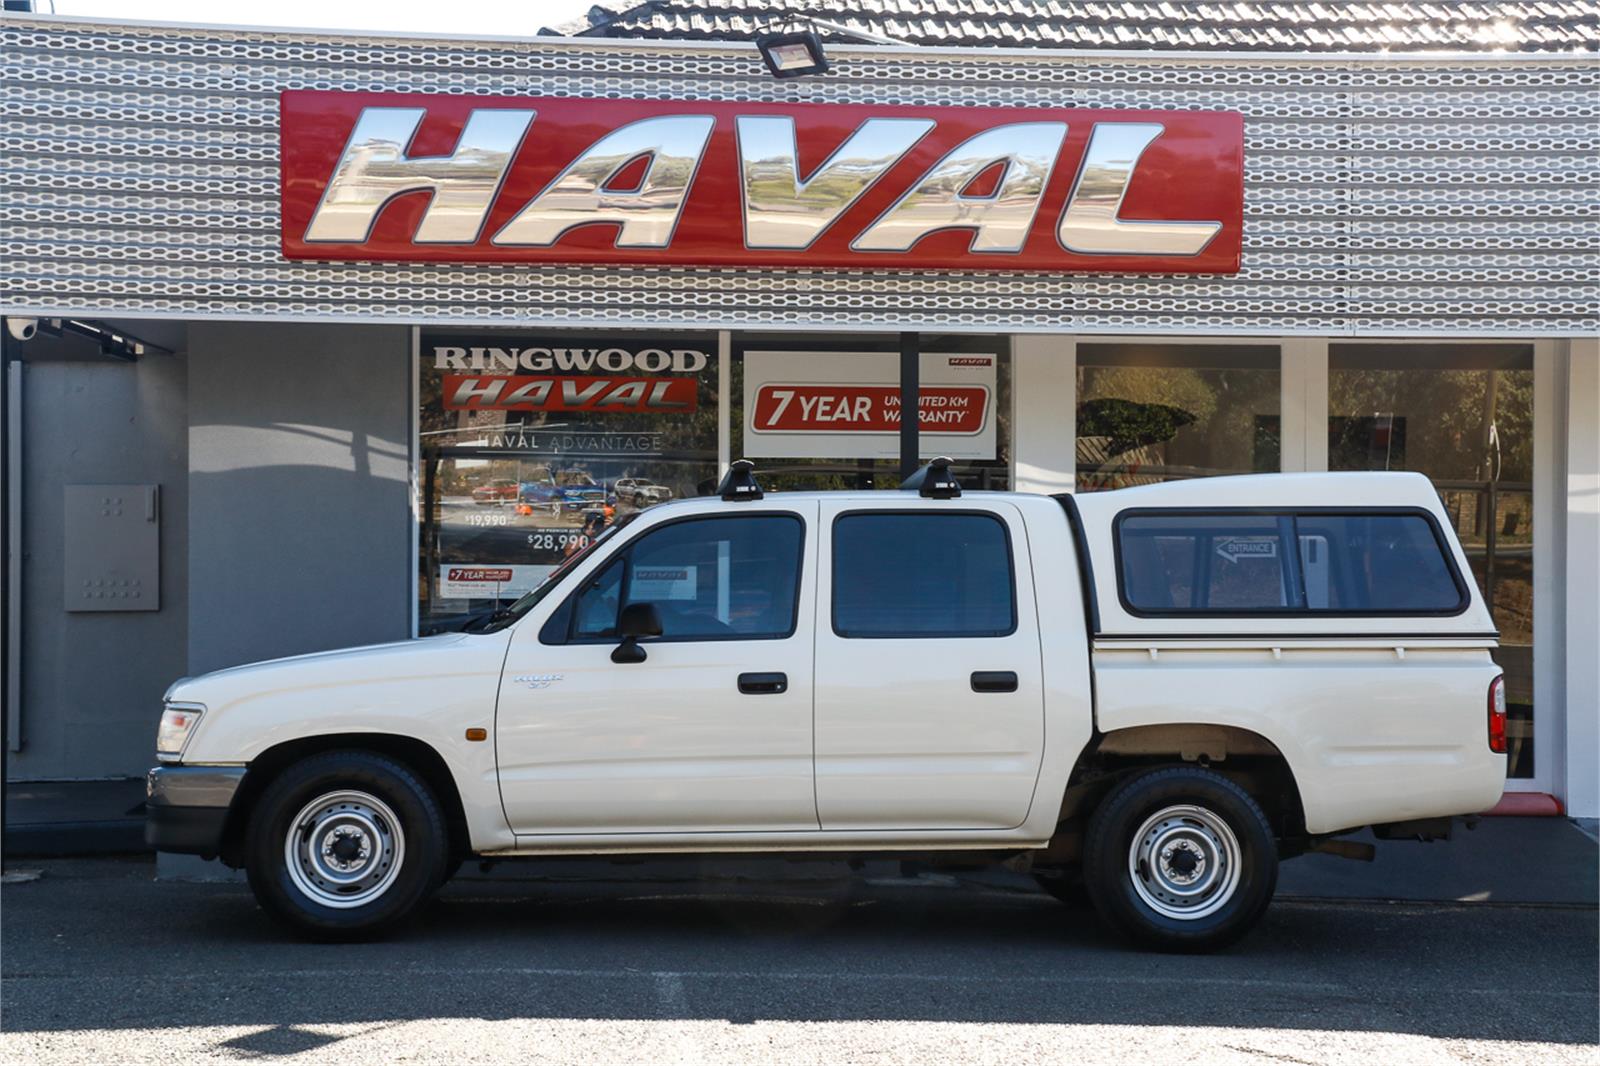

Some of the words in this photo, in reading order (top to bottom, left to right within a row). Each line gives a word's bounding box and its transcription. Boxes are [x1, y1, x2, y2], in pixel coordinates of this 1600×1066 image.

[303, 106, 1223, 256] HAVAL
[433, 346, 707, 373] RINGWOOD
[452, 378, 690, 408] HAVAL
[884, 395, 947, 407] UNITED
[949, 396, 969, 407] KM
[767, 391, 795, 426] 7
[799, 396, 873, 422] YEAR
[883, 409, 966, 423] WRANTY
[478, 435, 539, 449] HAVAL
[549, 437, 661, 451] ADVANTAGE
[528, 534, 589, 552] $28,990
[1228, 543, 1269, 553] ENTRANCE
[464, 570, 484, 579] YEAR
